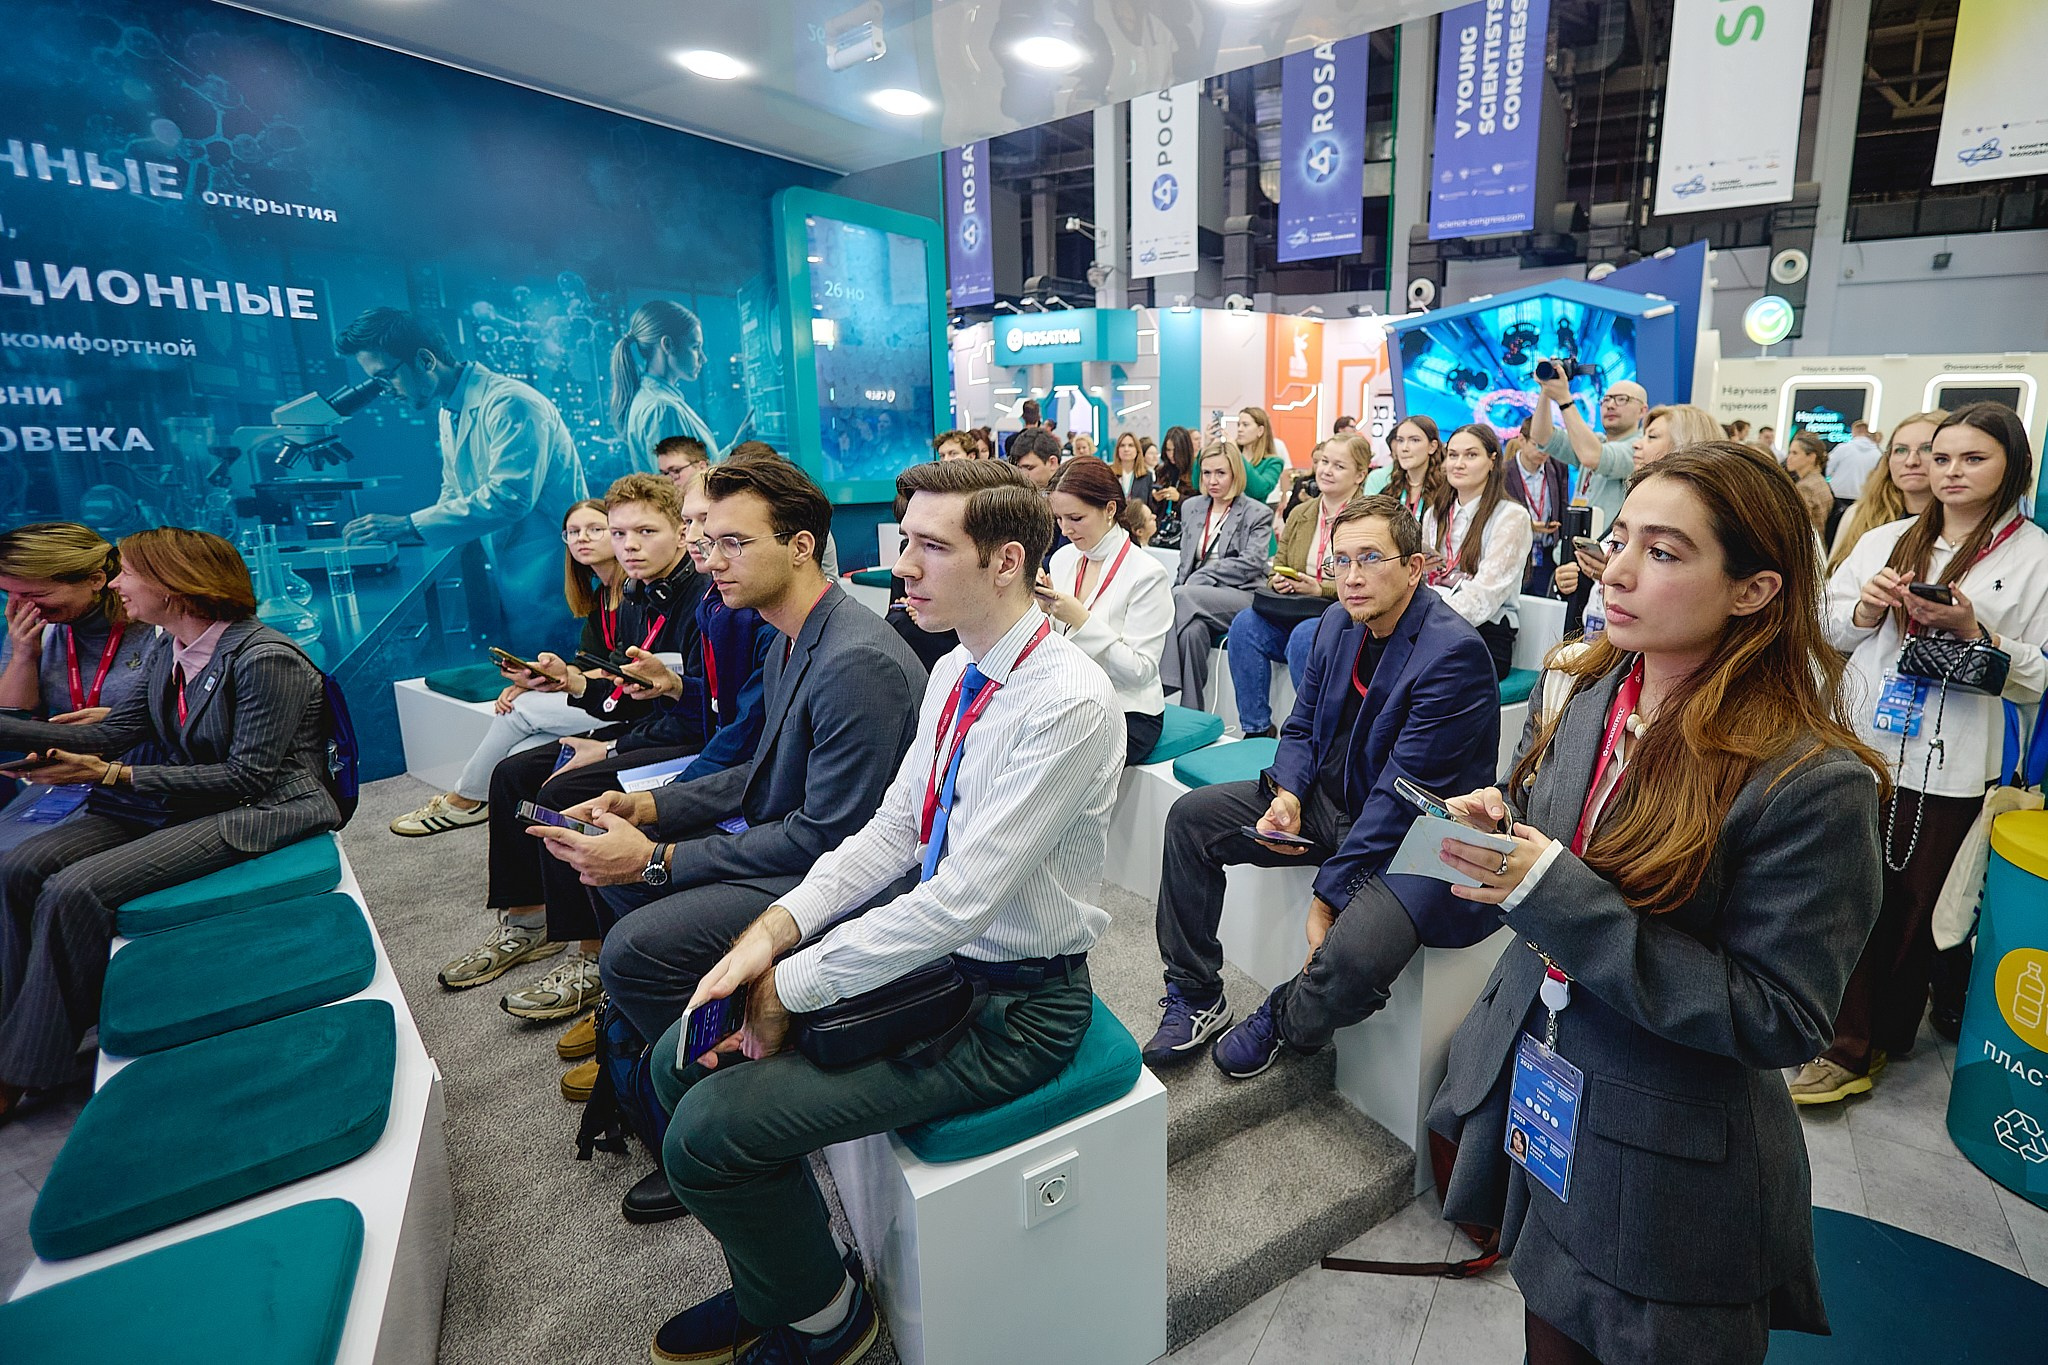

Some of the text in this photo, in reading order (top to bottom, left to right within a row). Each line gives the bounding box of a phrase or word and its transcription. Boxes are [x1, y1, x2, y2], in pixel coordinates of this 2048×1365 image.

[1716, 0, 1765, 46] S
[1312, 41, 1337, 133] ROSA
[1454, 26, 1478, 139] V YOUNG
[1478, 0, 1505, 135] SCIENTISTS
[1502, 0, 1529, 131] CONGRESS
[961, 144, 976, 214] ROSA
[202, 190, 338, 222] открытия
[0, 260, 318, 320] ЦИОННЫЕ
[824, 280, 843, 298] 26
[1, 332, 197, 357] комфортной
[1023, 328, 1081, 347] ROSATOM
[1983, 1040, 2048, 1086] ПЛАС
